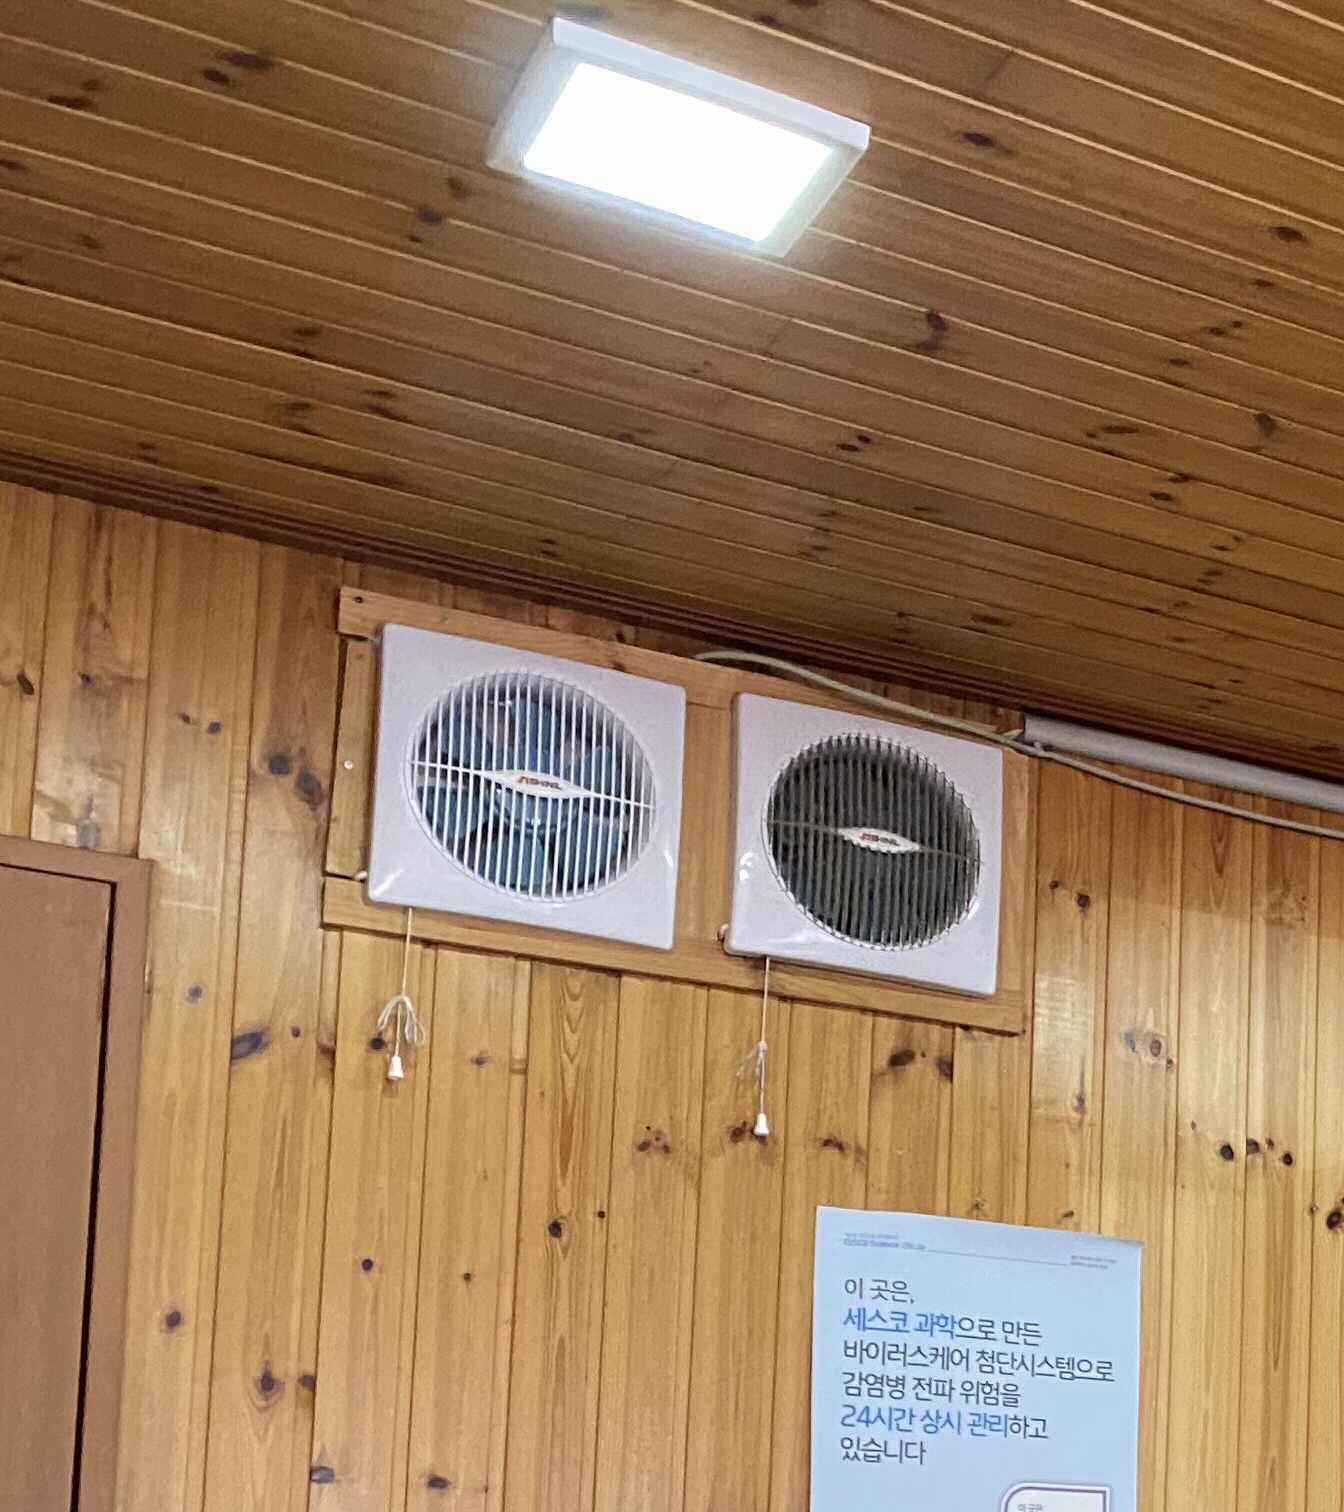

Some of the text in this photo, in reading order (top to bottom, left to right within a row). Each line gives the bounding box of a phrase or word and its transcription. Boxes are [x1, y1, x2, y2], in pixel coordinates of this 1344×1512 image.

[844, 1278, 864, 1300] 이
[843, 1307, 1042, 1347] 세스코 과학으로 만든
[843, 1340, 1115, 1383] 바이러스케어 첨단시스템으로
[842, 1372, 1021, 1408] 감염병 전파 위험을
[840, 1404, 1049, 1439] 24시간 상시 관리하고
[841, 1436, 926, 1465] 있습니다
